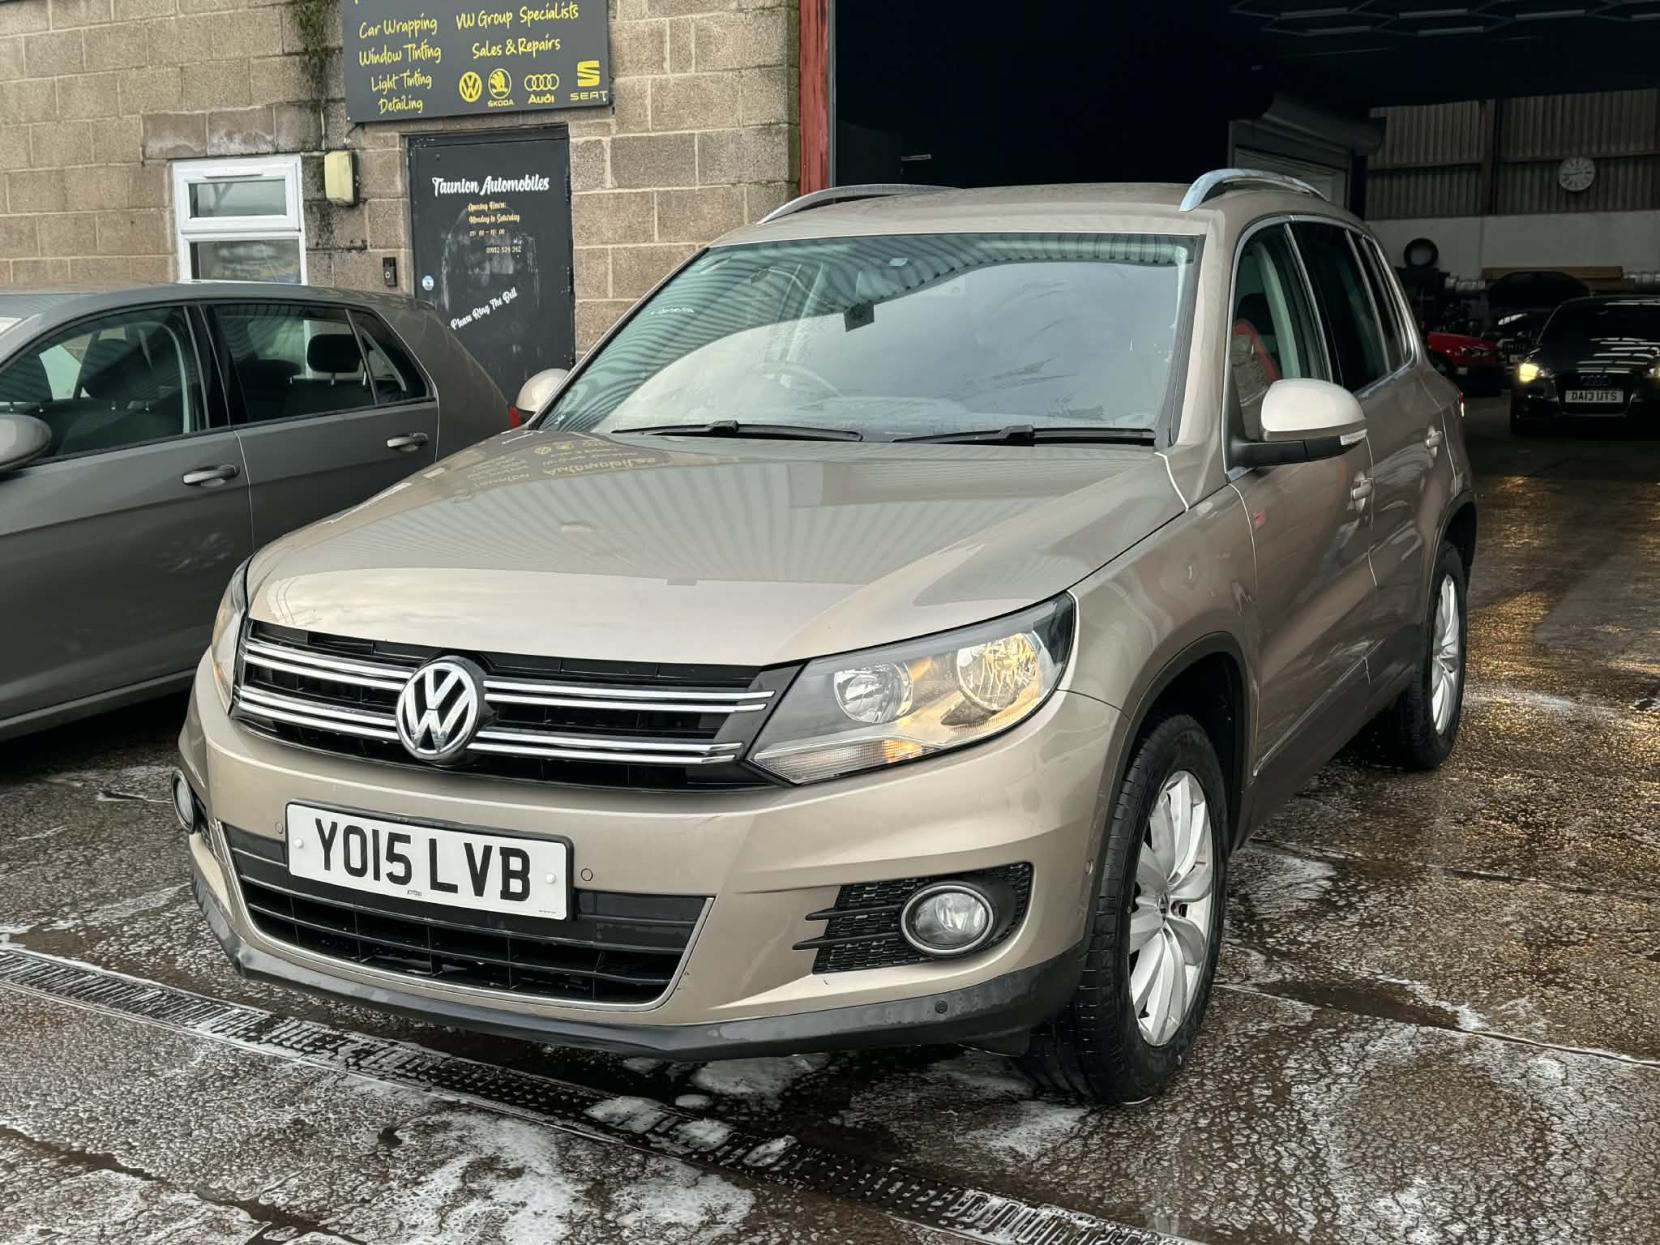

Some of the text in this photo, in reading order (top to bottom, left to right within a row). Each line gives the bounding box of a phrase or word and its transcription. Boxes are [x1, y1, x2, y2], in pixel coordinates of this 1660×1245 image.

[359, 13, 438, 39] Car Wrapping
[456, 2, 579, 31] VW Group Specialists
[359, 39, 441, 66] Window Tinting
[472, 33, 561, 60] Sales & Repairs
[371, 68, 432, 94] Light Tinting
[378, 94, 424, 114] Detailing
[528, 93, 555, 105] Audi
[570, 91, 608, 102] SEAT
[432, 174, 550, 197] Taunton Automobiles
[450, 286, 518, 330] Please Ring The Bell
[1597, 391, 1617, 401] UTS
[315, 817, 531, 902] YO15 LVB
